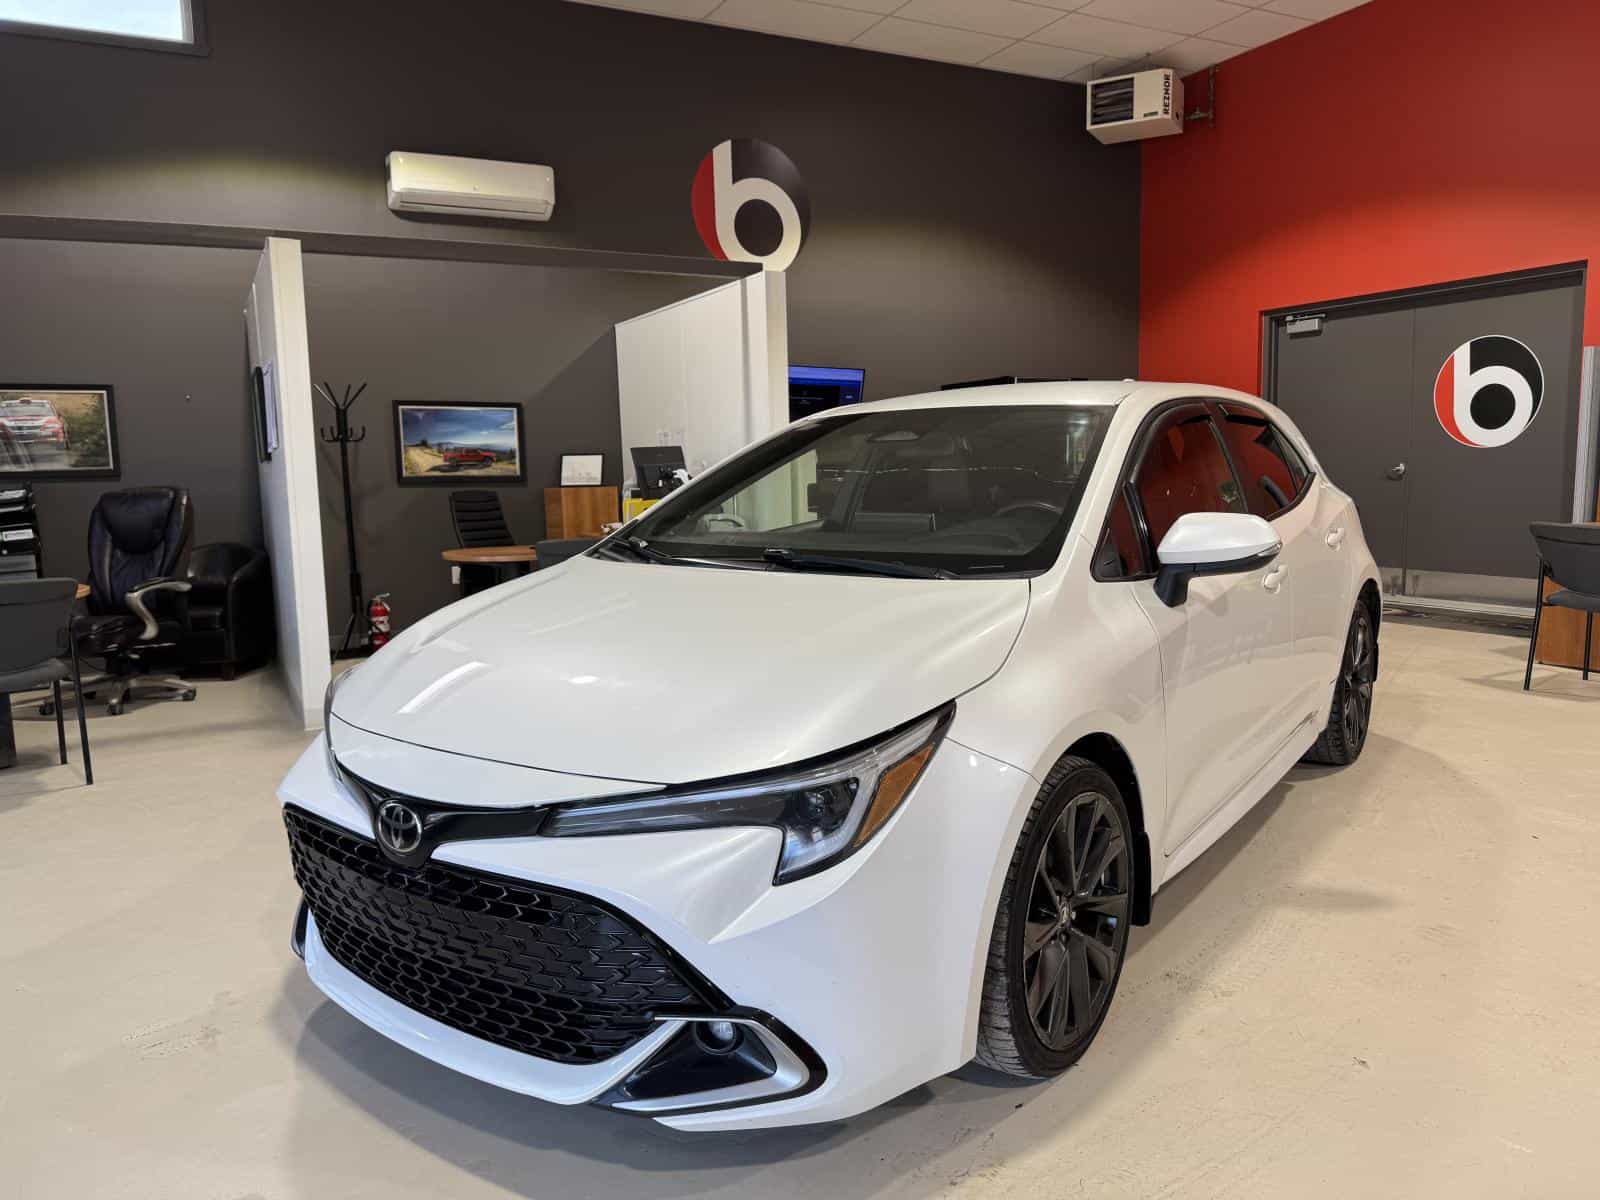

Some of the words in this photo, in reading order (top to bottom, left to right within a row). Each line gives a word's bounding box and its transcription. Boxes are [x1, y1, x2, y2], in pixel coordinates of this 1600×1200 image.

[1163, 74, 1171, 115] REZNOR
[712, 139, 802, 272] b
[1453, 340, 1534, 448] b
